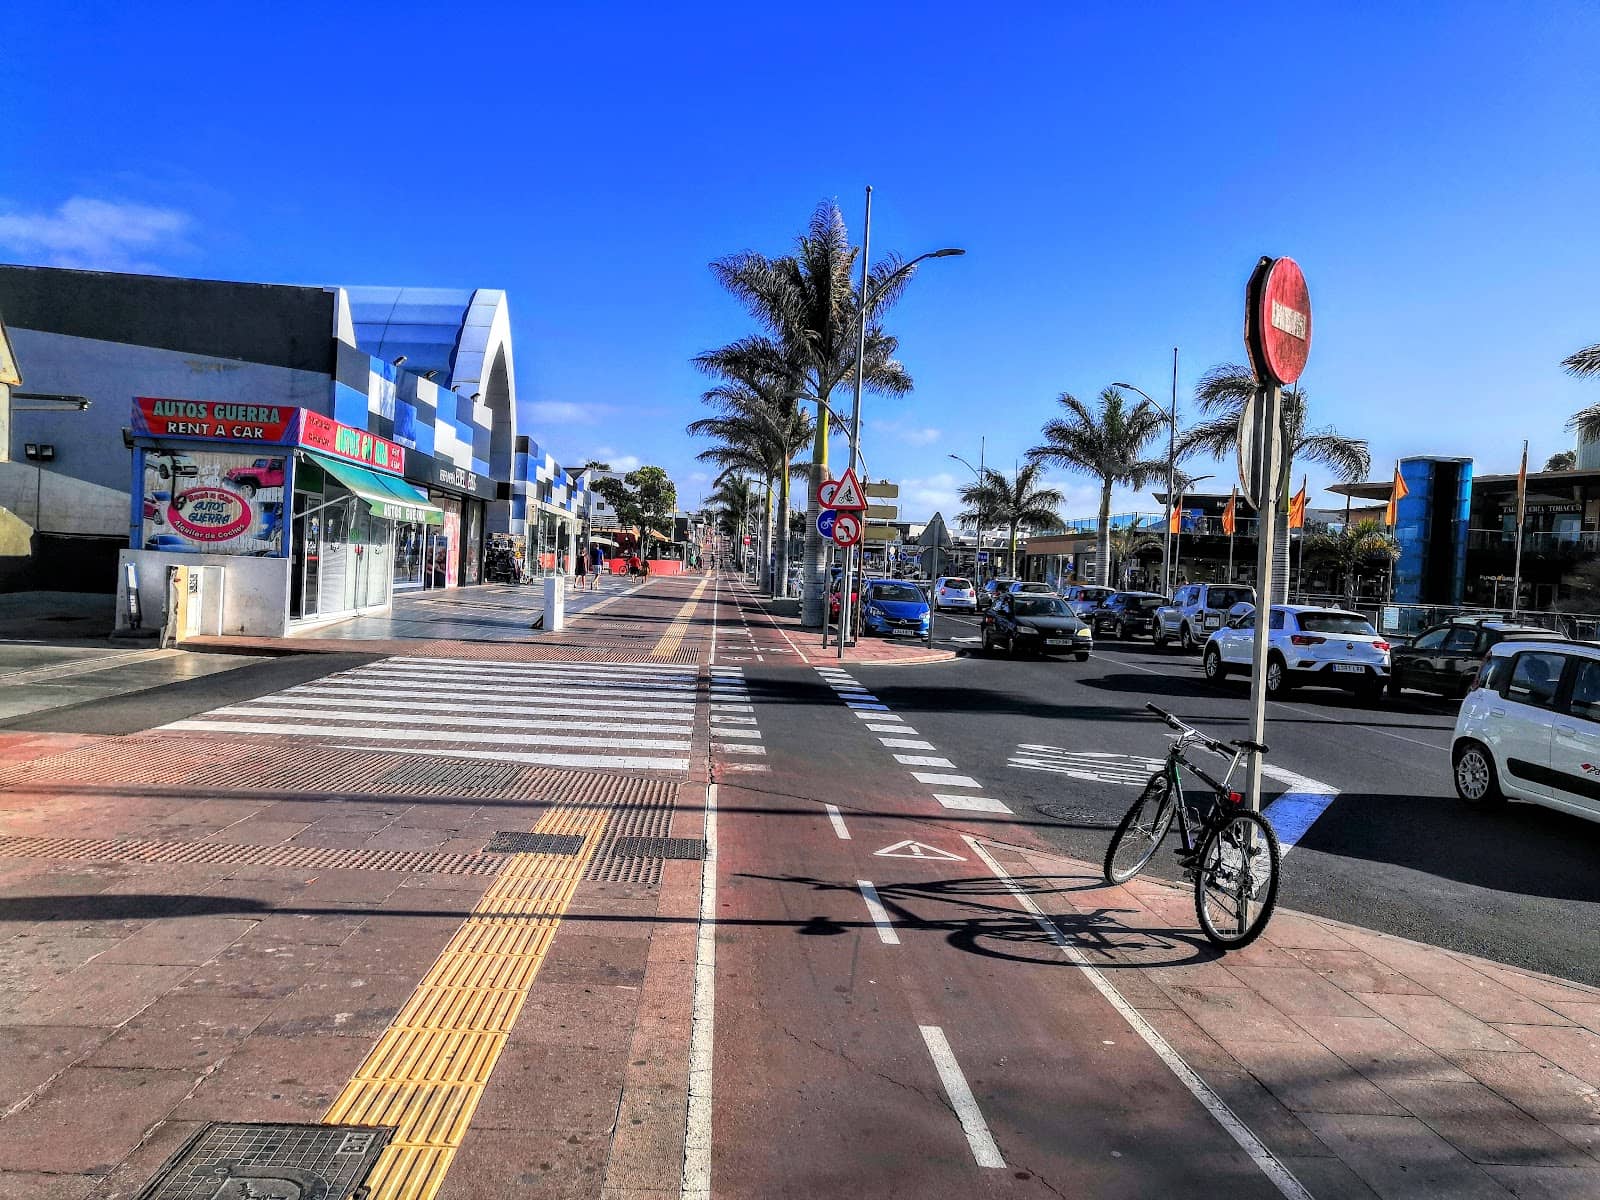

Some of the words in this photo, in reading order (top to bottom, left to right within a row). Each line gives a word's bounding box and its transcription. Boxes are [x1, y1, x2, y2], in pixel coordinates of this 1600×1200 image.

[153, 401, 207, 419] AUTOS
[213, 403, 280, 423] GUERRA
[168, 422, 210, 435] RENT
[214, 424, 226, 436] A
[231, 425, 264, 439] CAR
[193, 501, 226, 513] AUTOS
[188, 512, 231, 524] GUERRA
[174, 520, 204, 538] Alquiler
